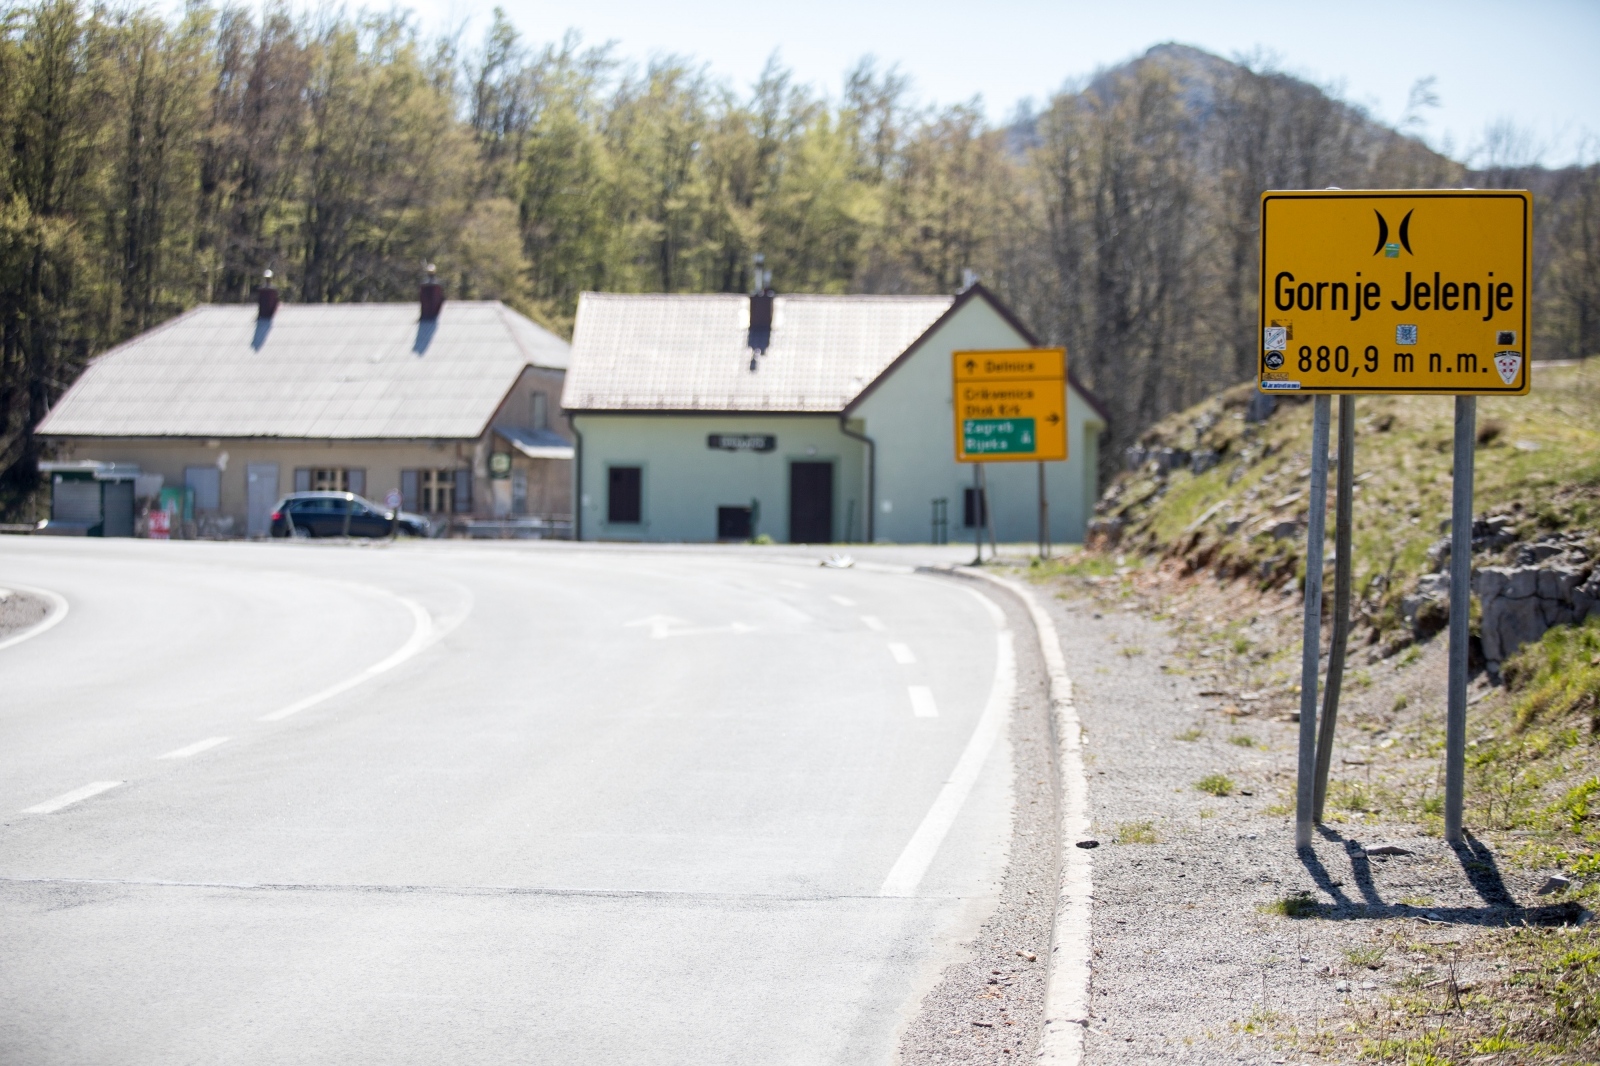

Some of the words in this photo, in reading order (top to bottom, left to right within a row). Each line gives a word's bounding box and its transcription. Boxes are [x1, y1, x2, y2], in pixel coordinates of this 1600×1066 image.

[1274, 271, 1381, 321] Gornje
[1391, 271, 1514, 321] Jelenje
[985, 361, 1034, 373] Delnice
[1298, 345, 1379, 378] 880,9
[1394, 353, 1414, 373] m
[1429, 353, 1488, 373] n.m.
[964, 421, 1014, 436] Zagreb
[965, 438, 1008, 453] Rijeka
